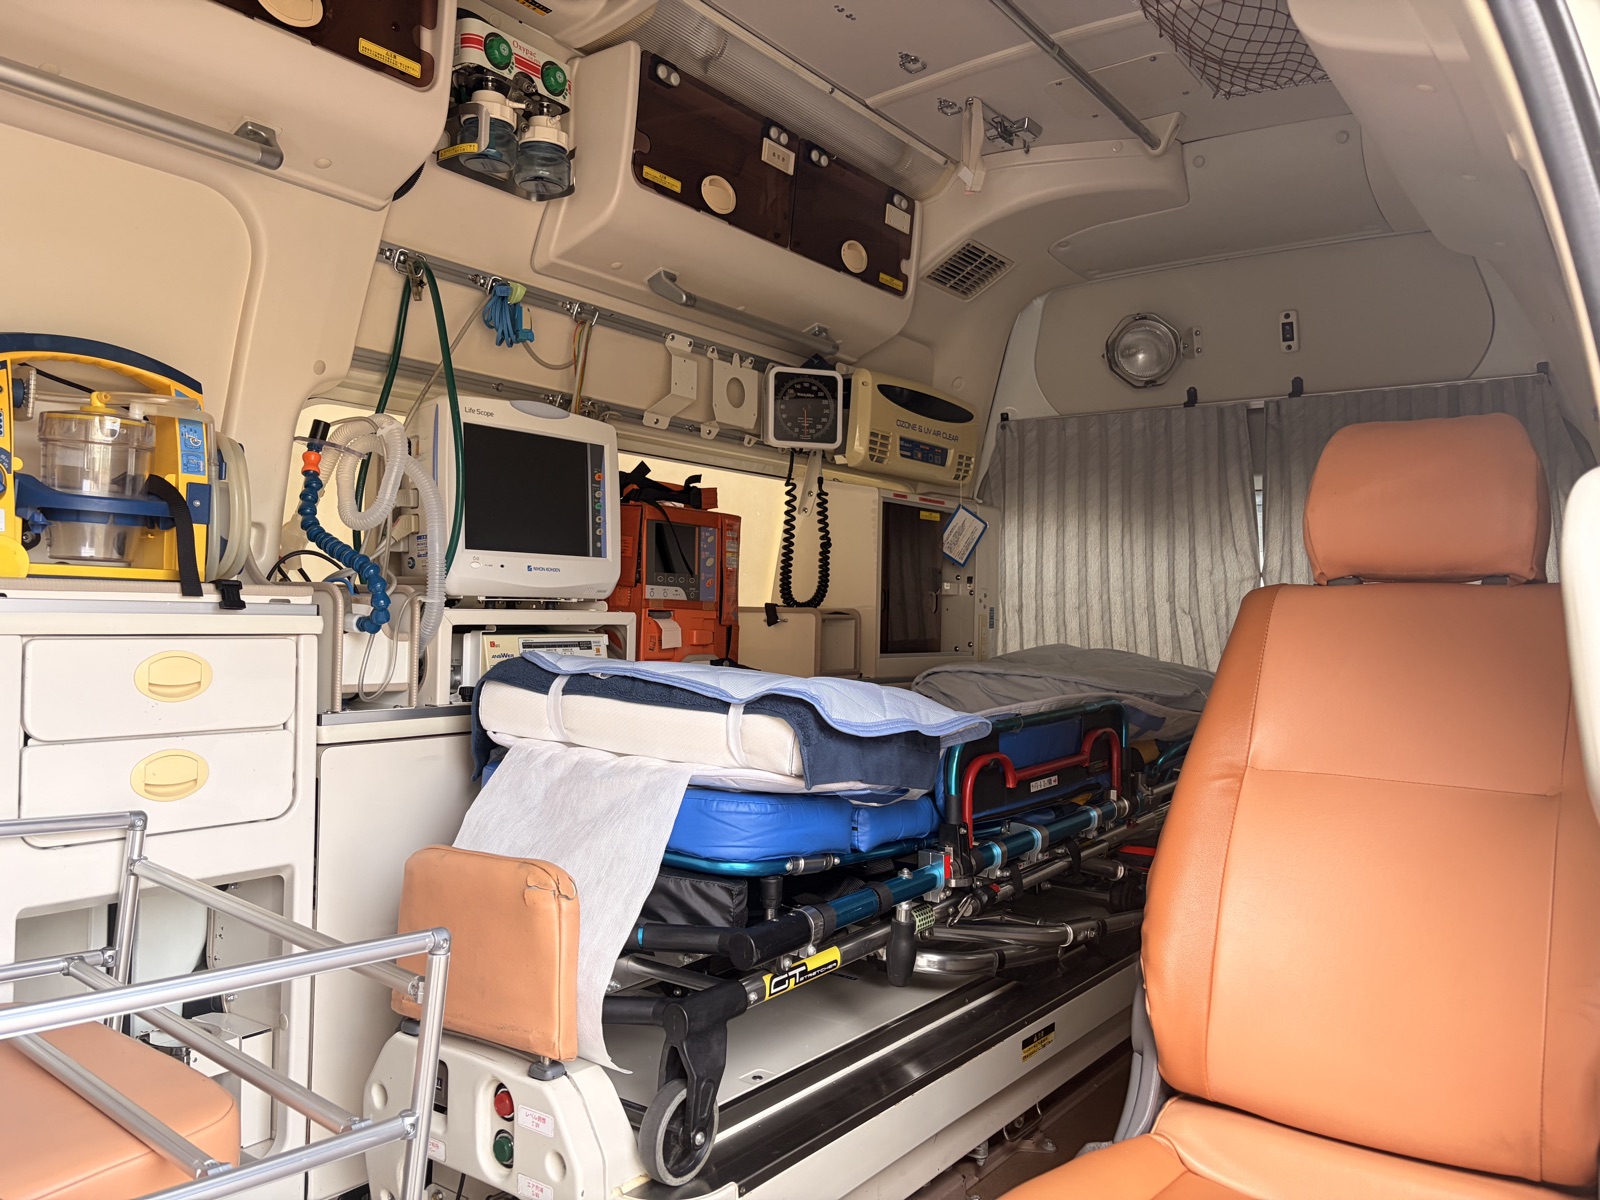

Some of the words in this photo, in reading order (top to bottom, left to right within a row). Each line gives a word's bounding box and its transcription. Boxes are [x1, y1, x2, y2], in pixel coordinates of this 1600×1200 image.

[512, 40, 537, 58] Oxypac
[464, 406, 476, 414] Life
[476, 408, 495, 418] Scope
[896, 419, 917, 431] OZONE
[918, 425, 923, 433] &
[932, 429, 941, 437] AIR
[942, 432, 959, 442] CLEAR
[799, 962, 837, 982] STRETCHER
